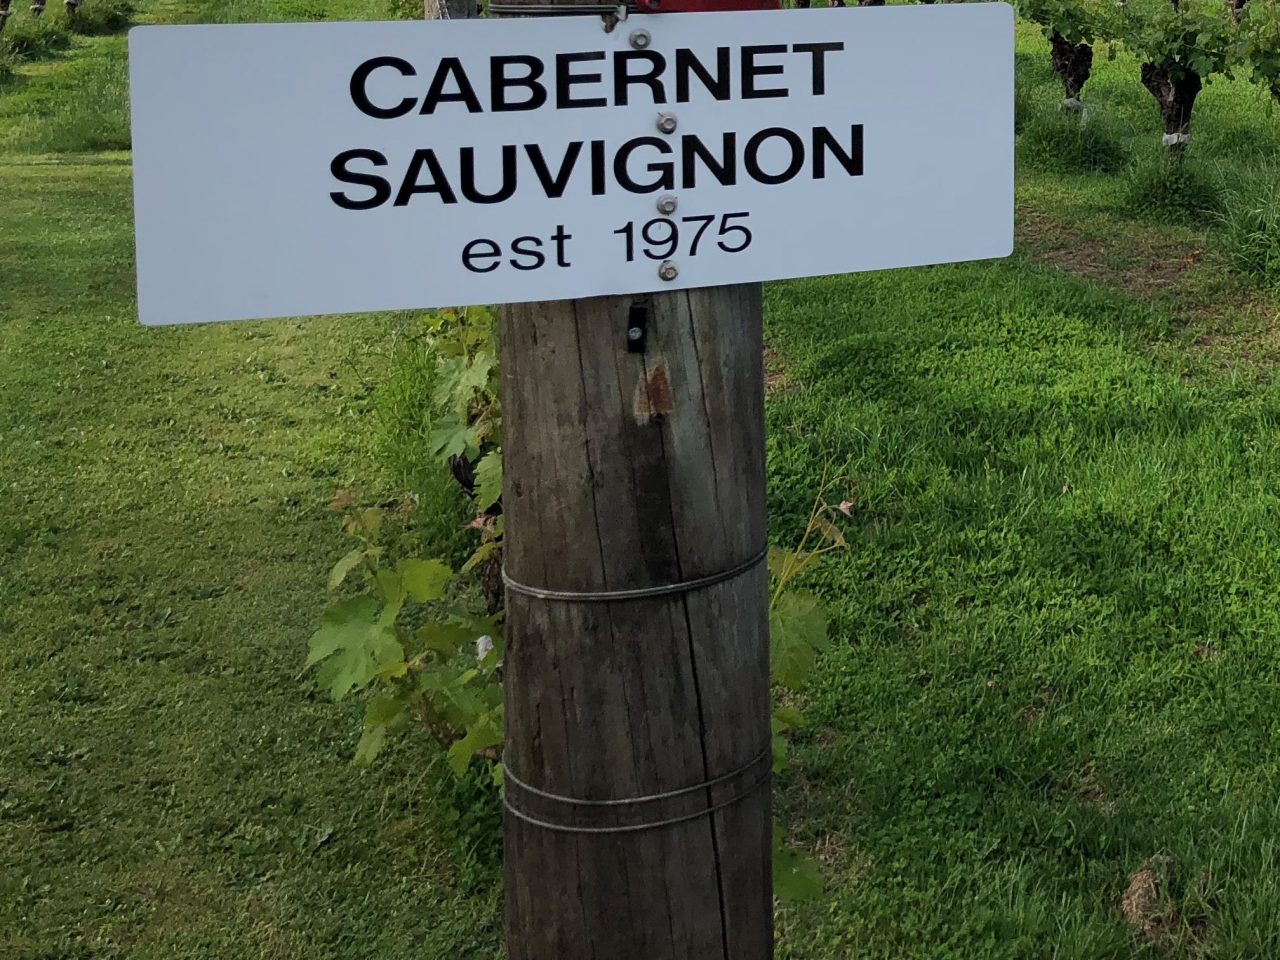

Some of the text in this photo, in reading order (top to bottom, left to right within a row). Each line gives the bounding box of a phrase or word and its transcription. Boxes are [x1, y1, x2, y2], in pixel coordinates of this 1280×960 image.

[349, 41, 845, 120] CABERNET
[329, 123, 865, 211] SAUVIGNON
[461, 211, 753, 274] est 1975
